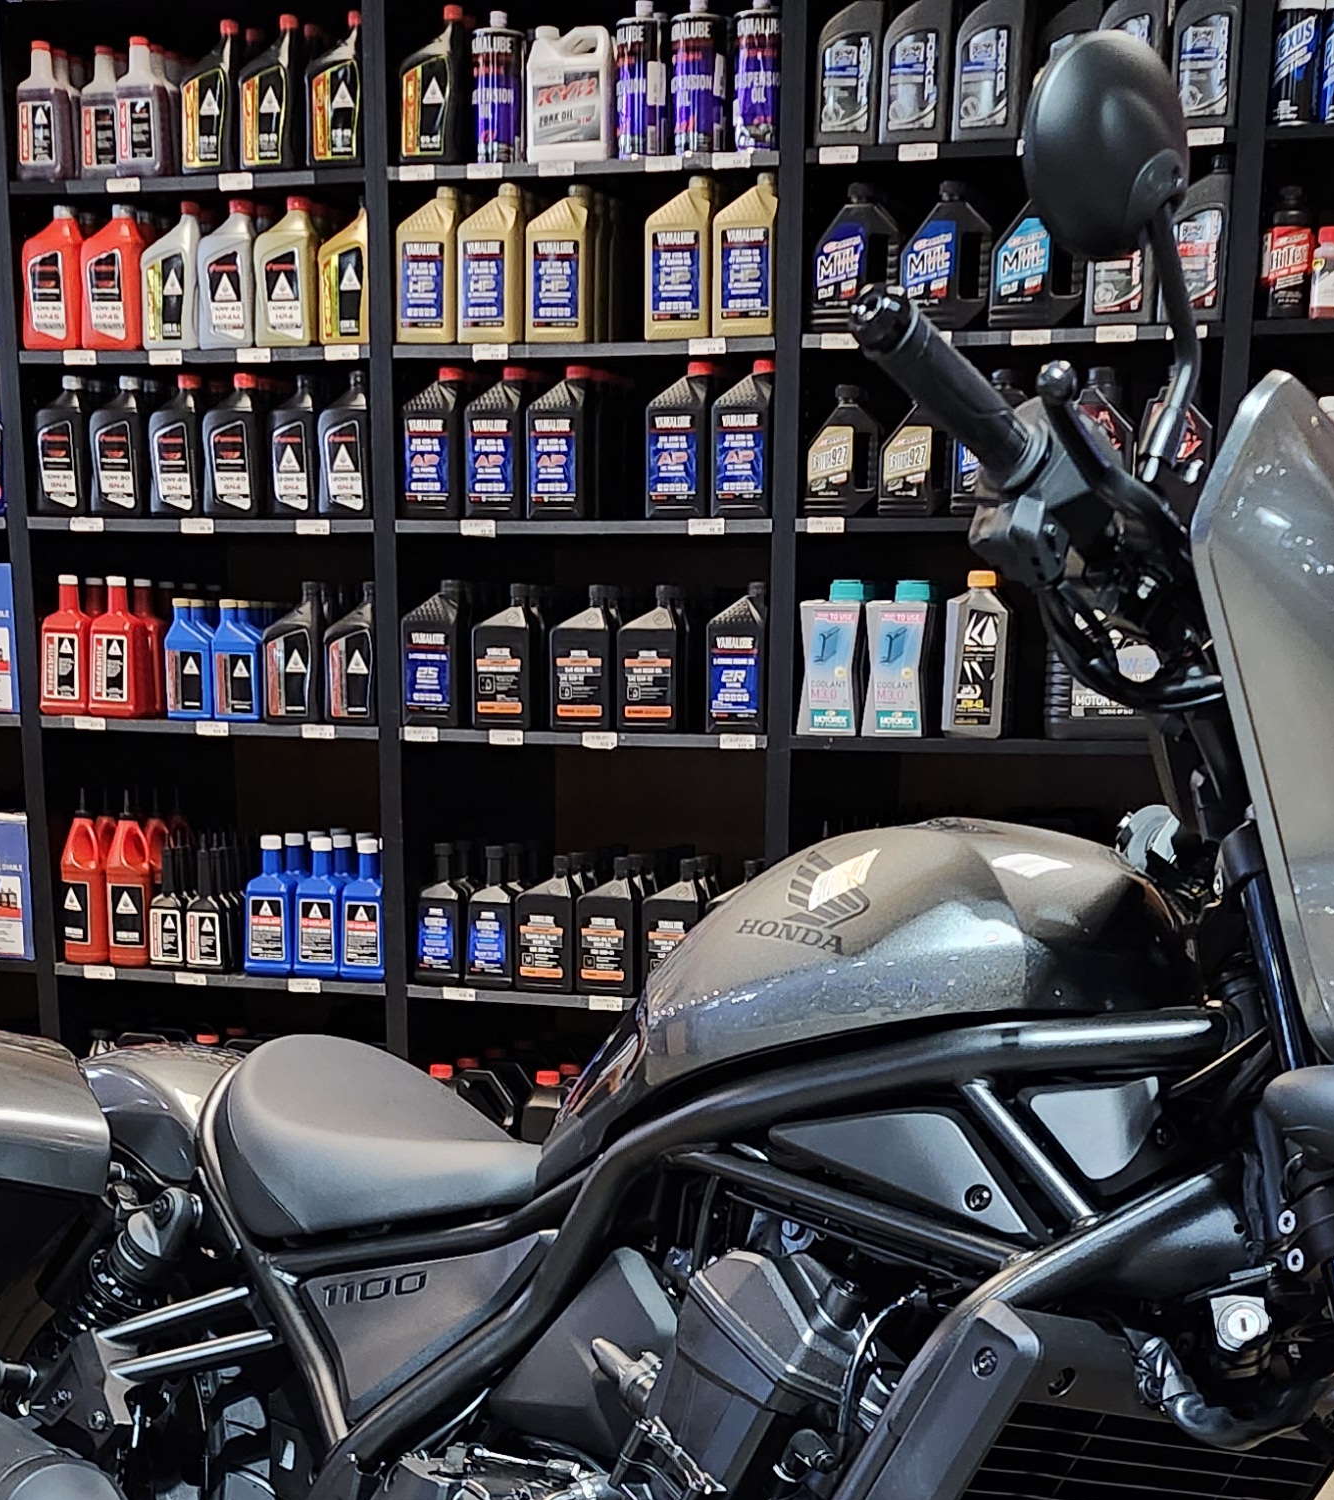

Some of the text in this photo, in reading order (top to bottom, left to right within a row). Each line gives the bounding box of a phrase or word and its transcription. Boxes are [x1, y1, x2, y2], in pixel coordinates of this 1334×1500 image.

[811, 680, 847, 689] COOLANT
[877, 681, 913, 689] COOLANT
[811, 689, 837, 700] M3.0
[877, 690, 905, 701] M3.0
[735, 919, 845, 956] HONDA
[321, 1269, 428, 1308] 1100
